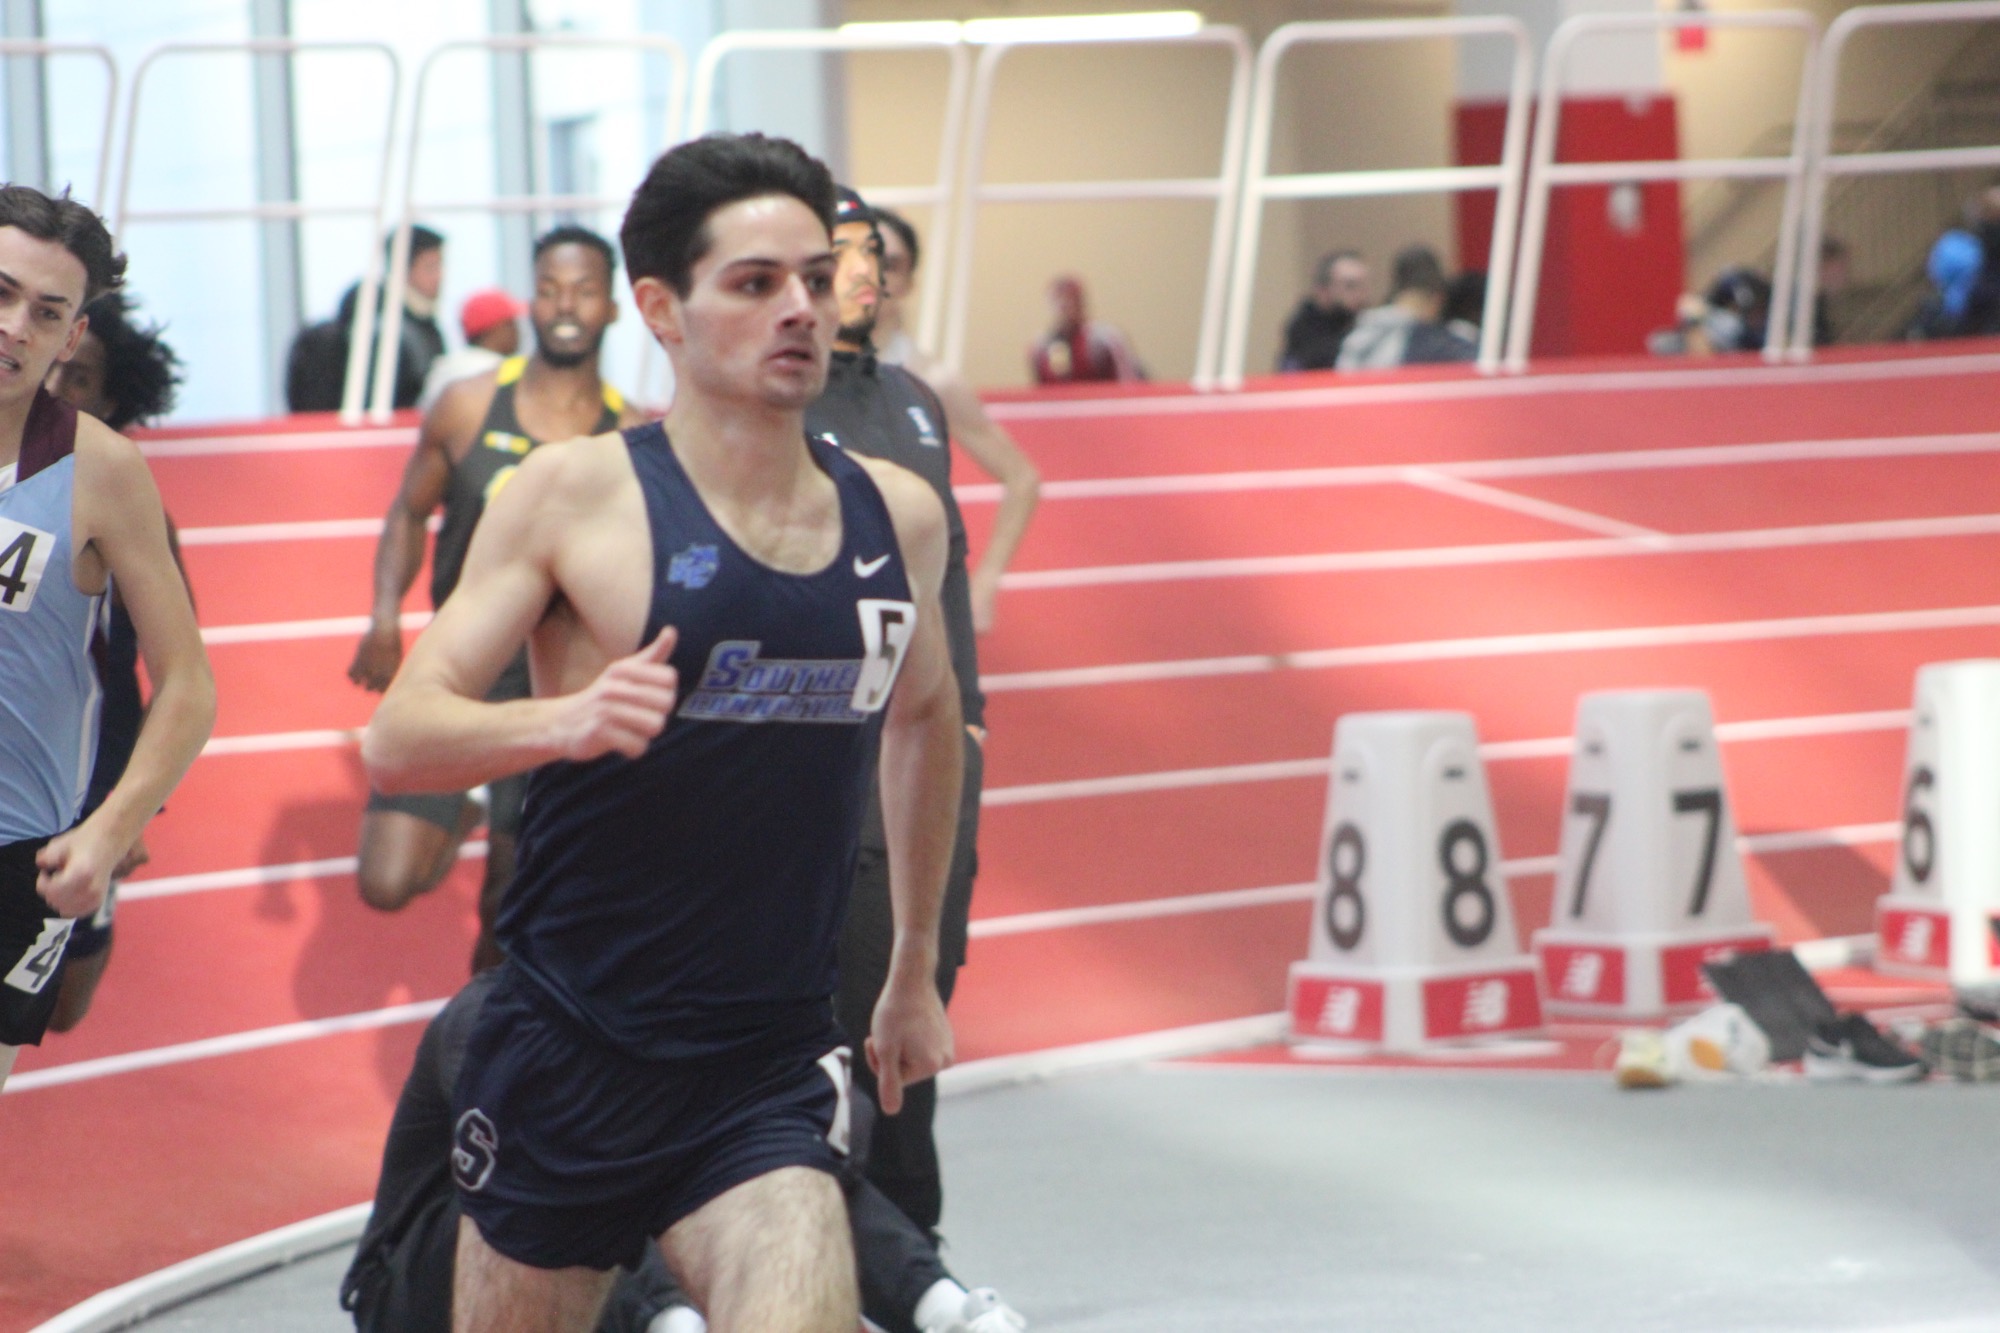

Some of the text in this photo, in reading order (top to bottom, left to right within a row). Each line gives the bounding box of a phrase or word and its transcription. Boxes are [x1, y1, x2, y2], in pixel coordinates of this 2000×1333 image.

[0, 531, 37, 605] 4
[704, 643, 864, 691] SOUTHE
[867, 609, 904, 705] 5
[1439, 818, 1496, 948] 8
[1571, 791, 1612, 920] 7
[1672, 788, 1722, 918] 7
[1905, 765, 1935, 885] 6
[1326, 823, 1366, 951] 8
[451, 1107, 499, 1191] S
